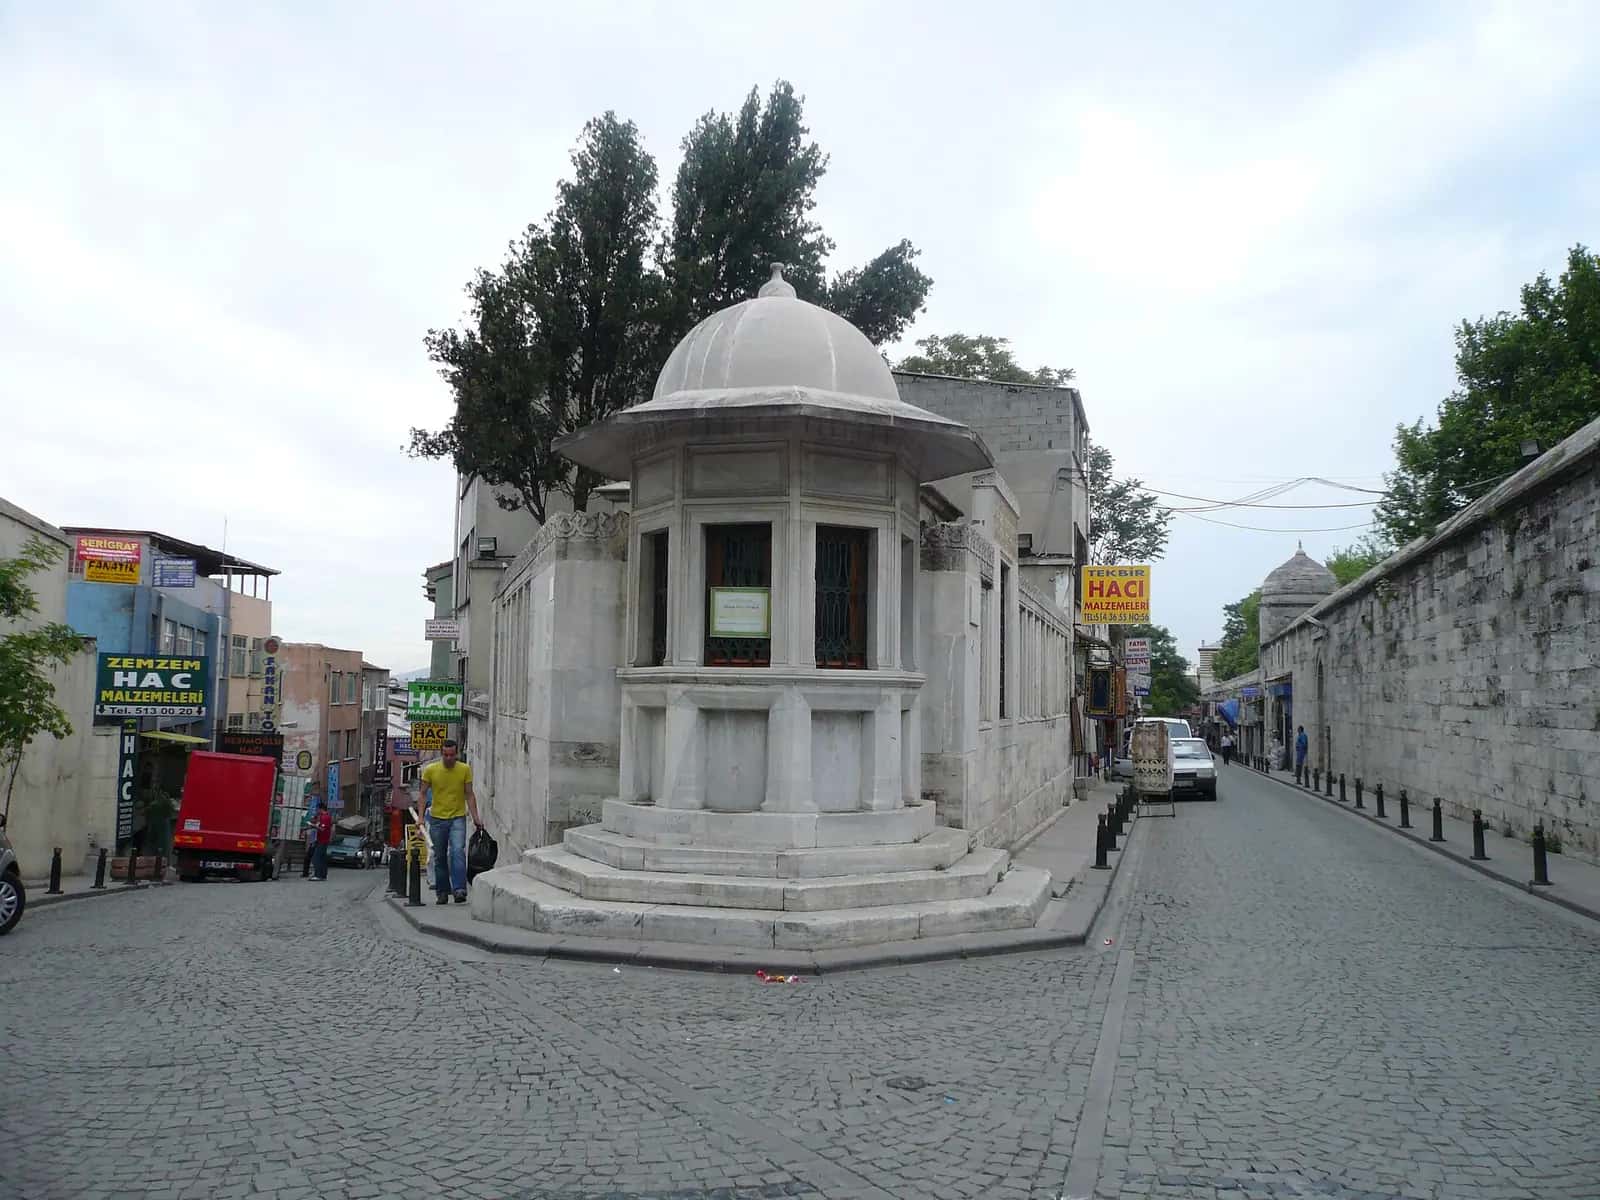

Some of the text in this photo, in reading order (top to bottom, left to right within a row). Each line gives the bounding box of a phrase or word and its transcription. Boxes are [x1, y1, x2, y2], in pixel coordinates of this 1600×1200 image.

[1088, 580, 1144, 598] HACI
[107, 657, 201, 671] ZEMZEM
[113, 671, 192, 688] HAC
[101, 689, 204, 704] MALZEMELERİ
[408, 691, 463, 709] HACI
[110, 706, 193, 716] Tel. 513 00 20
[413, 728, 446, 739] HAC
[122, 735, 135, 800] HAC
